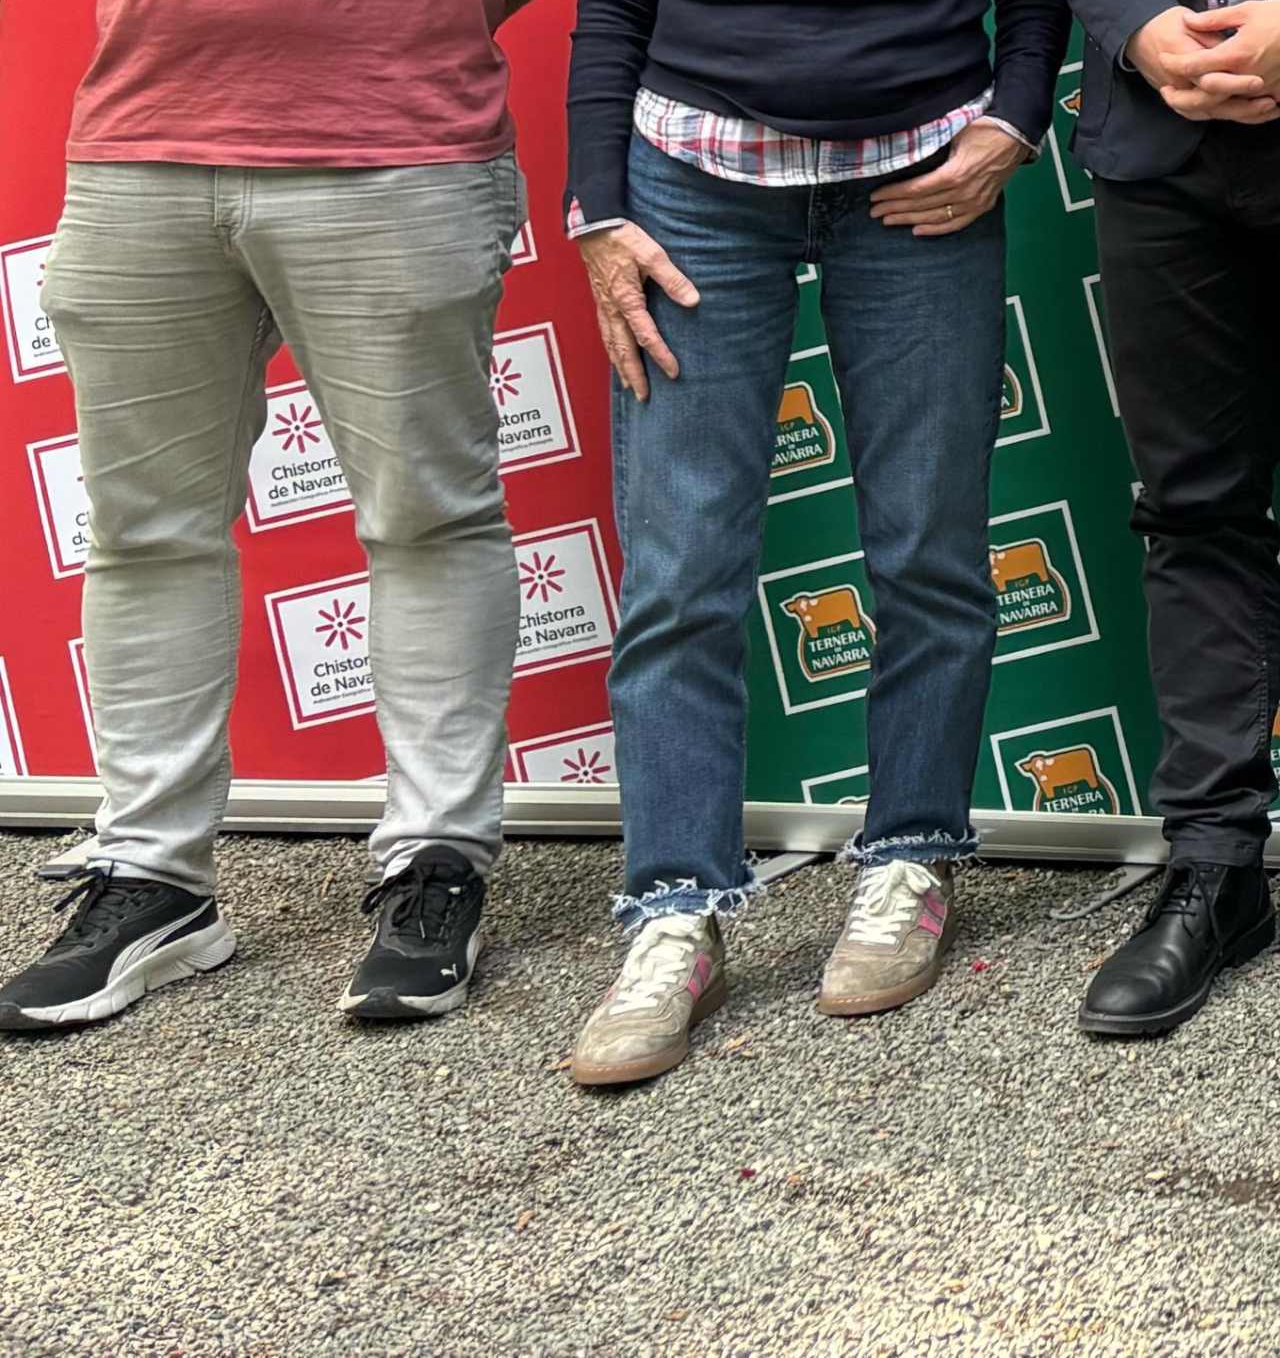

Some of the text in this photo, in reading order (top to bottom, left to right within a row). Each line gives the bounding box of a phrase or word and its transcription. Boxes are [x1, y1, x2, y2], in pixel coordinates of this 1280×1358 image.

[31, 336, 51, 350] de
[499, 409, 542, 428] storra
[774, 426, 820, 447] RNERA
[771, 443, 823, 466] AVARRA
[268, 485, 289, 500] de
[292, 473, 345, 495] Navarr
[995, 584, 1055, 607] TERNERA
[1000, 601, 1058, 624] NAVARRA
[535, 621, 596, 644] Navarra
[808, 630, 866, 653] TERNERA
[313, 656, 370, 678] Chistor
[811, 647, 870, 670] NAVARRA
[310, 682, 331, 697] de
[334, 672, 375, 692] Nava
[1044, 790, 1104, 813] TERNERA
